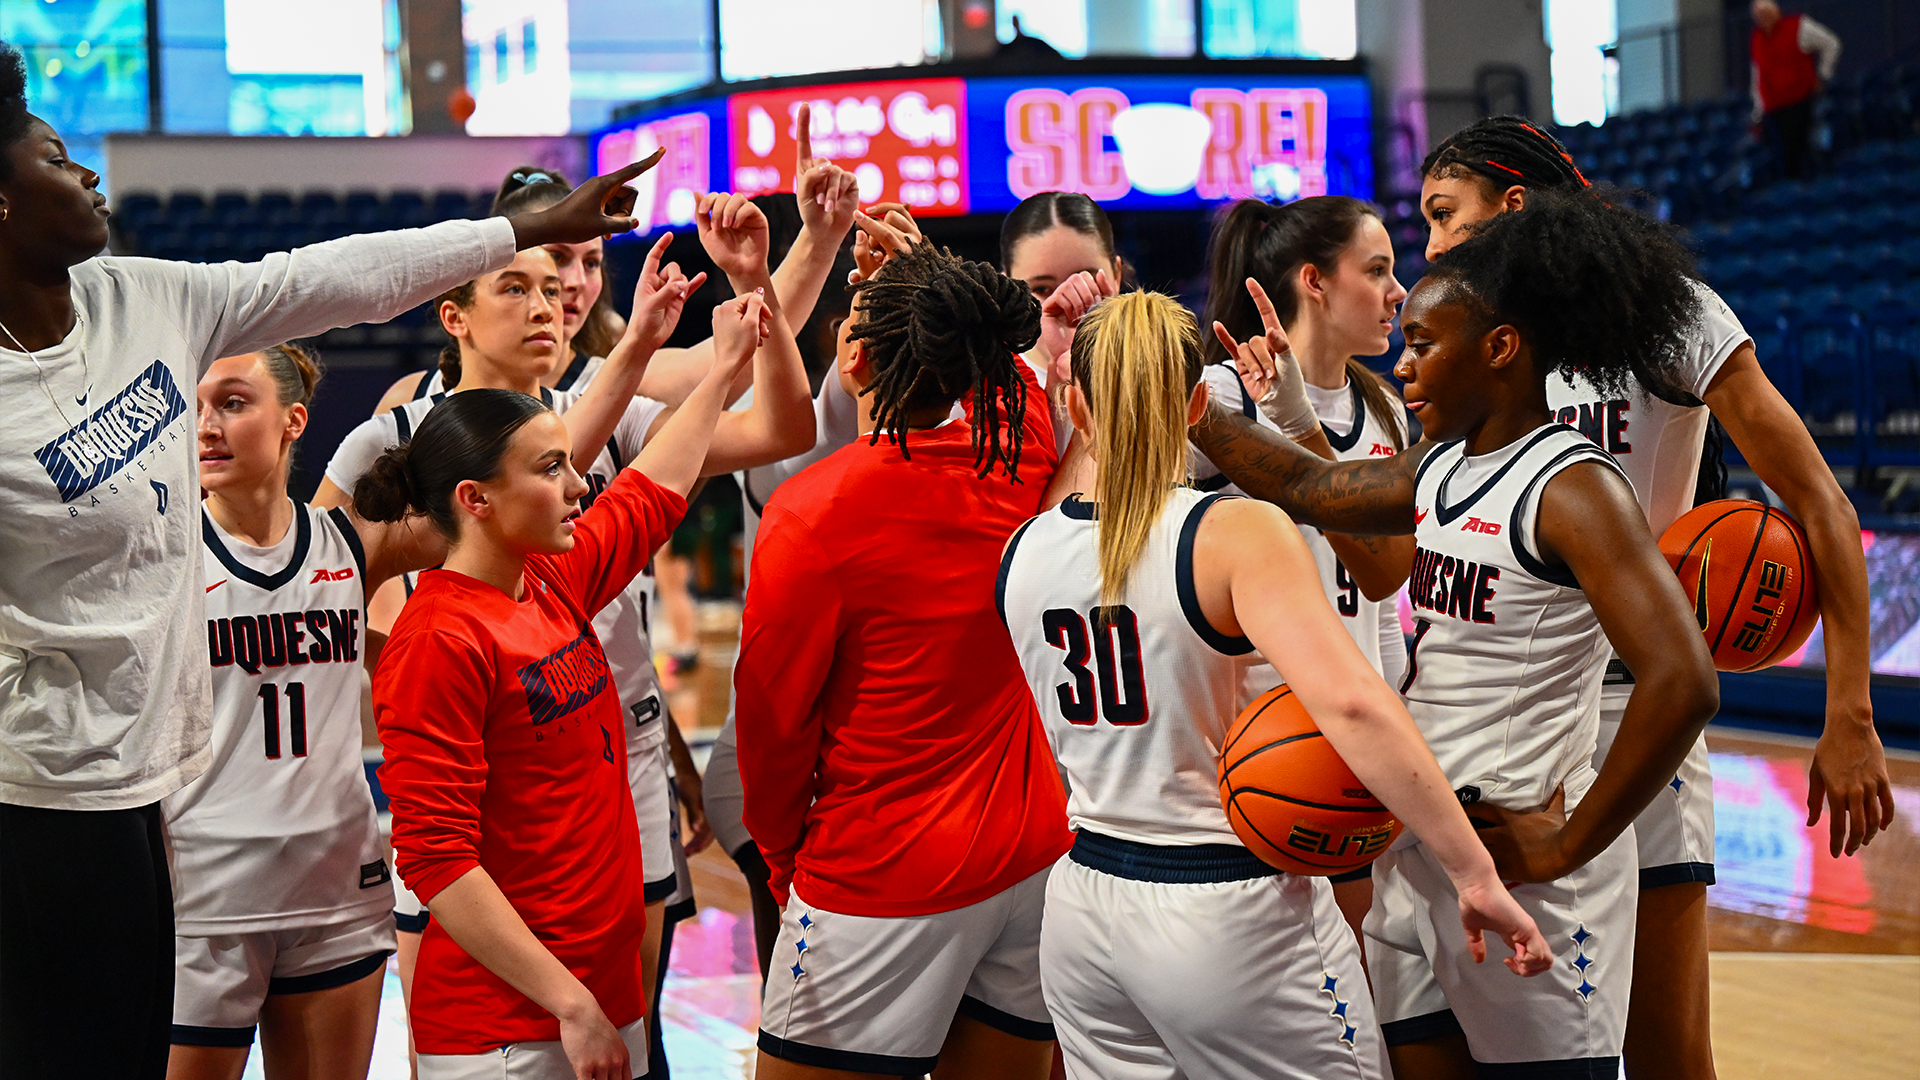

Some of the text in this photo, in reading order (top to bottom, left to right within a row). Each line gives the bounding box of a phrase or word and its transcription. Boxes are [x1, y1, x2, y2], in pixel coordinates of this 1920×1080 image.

[1006, 88, 1327, 200] SCRE!
[1461, 516, 1502, 535] A10
[310, 567, 354, 585] A10
[1336, 555, 1358, 617] 9
[1731, 559, 1787, 653] ELITE
[1042, 604, 1149, 726] 30
[257, 682, 308, 760] 11
[1461, 792, 1472, 802] M
[1287, 825, 1393, 857] ELITE
